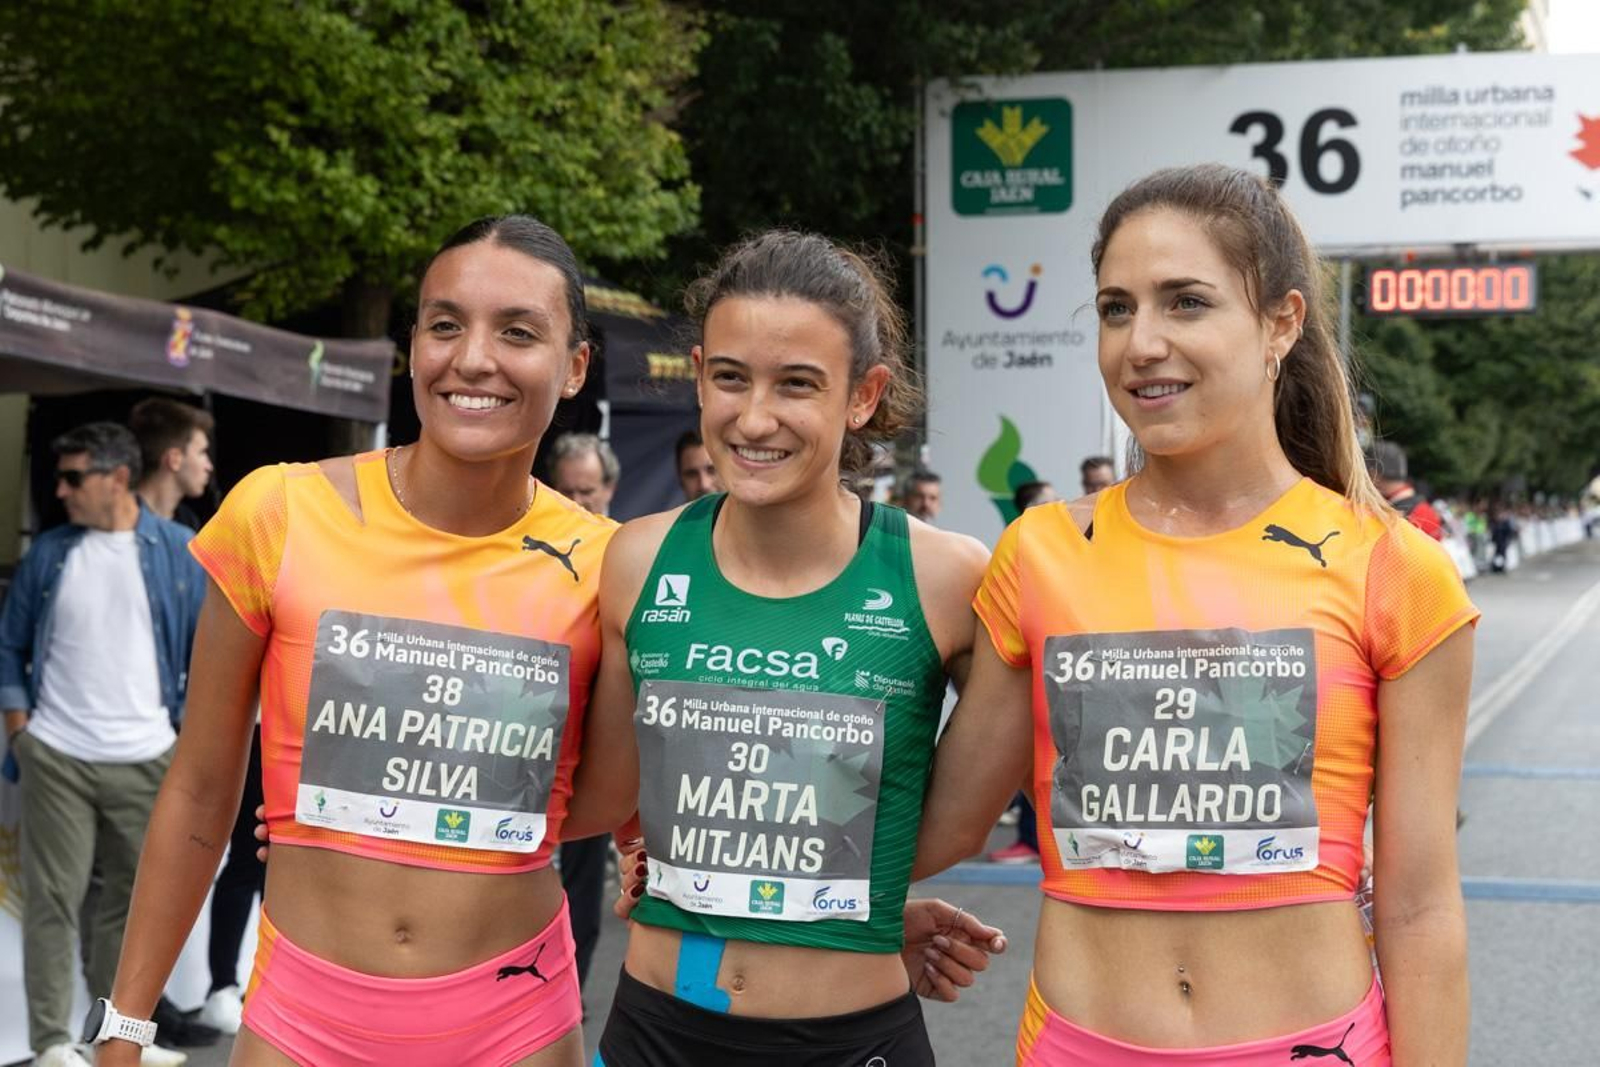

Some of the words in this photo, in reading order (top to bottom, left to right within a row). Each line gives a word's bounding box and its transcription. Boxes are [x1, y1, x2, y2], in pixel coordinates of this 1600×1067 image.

[1401, 86, 1458, 106] milla
[1465, 85, 1554, 104] urbana
[1401, 109, 1550, 130] internacional
[1229, 108, 1361, 195] 36
[1401, 138, 1428, 155] de
[1401, 159, 1493, 179] manuel
[1401, 184, 1523, 209] pancorbo
[942, 329, 1085, 350] Ayuntamiento
[972, 353, 997, 369] de
[1002, 350, 1053, 369] Jaén
[328, 625, 370, 658] 36
[377, 632, 404, 643] Milla
[407, 635, 444, 649] Urbana
[447, 640, 514, 659] internacional
[516, 651, 528, 662] de
[1102, 649, 1130, 660] Milla
[1133, 648, 1174, 659] Urbana
[1177, 644, 1250, 658] internacional
[1253, 646, 1267, 657] de
[375, 642, 456, 669] Manuel
[462, 653, 559, 684] Pancorbo
[685, 643, 820, 679] Facsa
[1055, 650, 1095, 683] 36
[1100, 658, 1188, 680] Manuel
[1194, 656, 1306, 679] Pancorbo
[422, 674, 464, 706] 38
[698, 675, 723, 684] ciclo
[727, 677, 769, 688] integral
[642, 695, 677, 728] 36
[683, 699, 707, 710] Milla
[710, 701, 749, 714] Urbana
[752, 704, 824, 720] internacional
[826, 711, 840, 721] de
[843, 714, 874, 726] otoño
[1154, 688, 1197, 720] 29
[312, 700, 387, 742] ANA
[397, 709, 554, 761] PATRICIA
[681, 709, 761, 735] Manuel
[768, 717, 874, 745] Pancorbo
[728, 742, 770, 773] 30
[1103, 726, 1252, 772] CARLA
[382, 757, 479, 801] SILVA
[676, 774, 819, 827] MARTA
[1081, 784, 1282, 823] GALLARDO
[495, 817, 533, 842] Forus
[670, 825, 825, 873] MITJANS
[1256, 836, 1303, 862] Forus
[813, 886, 857, 910] Forus
